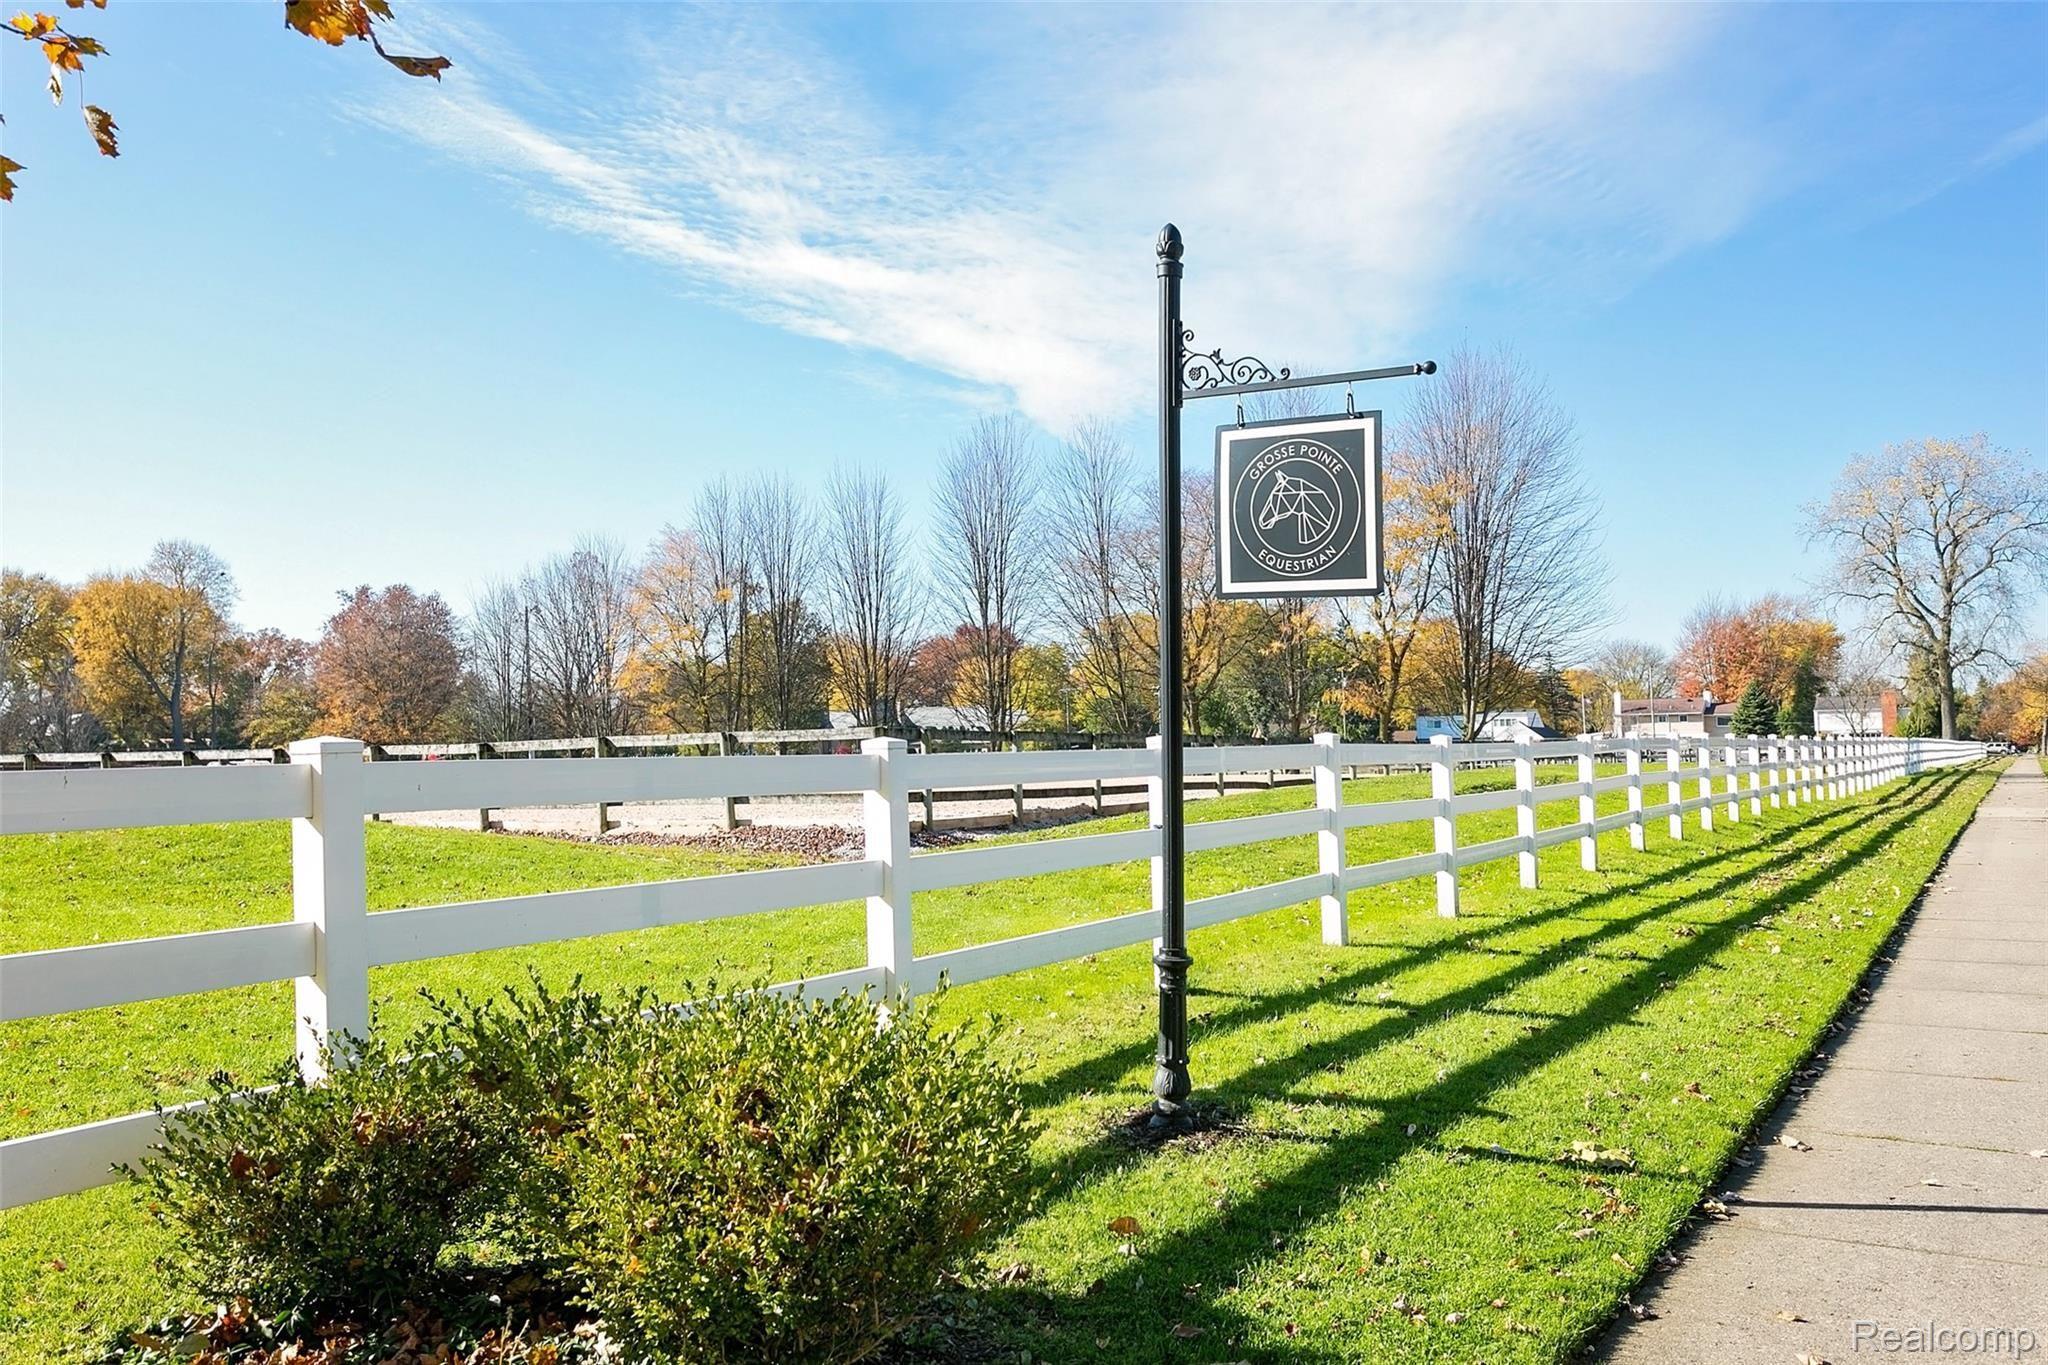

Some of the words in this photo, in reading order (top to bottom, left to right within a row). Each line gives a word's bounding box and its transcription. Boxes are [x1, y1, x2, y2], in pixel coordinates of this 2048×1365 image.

[1249, 445, 1295, 479] GROSSE
[1300, 445, 1343, 474] POINTE
[1258, 545, 1337, 571] EQUESTRIAN
